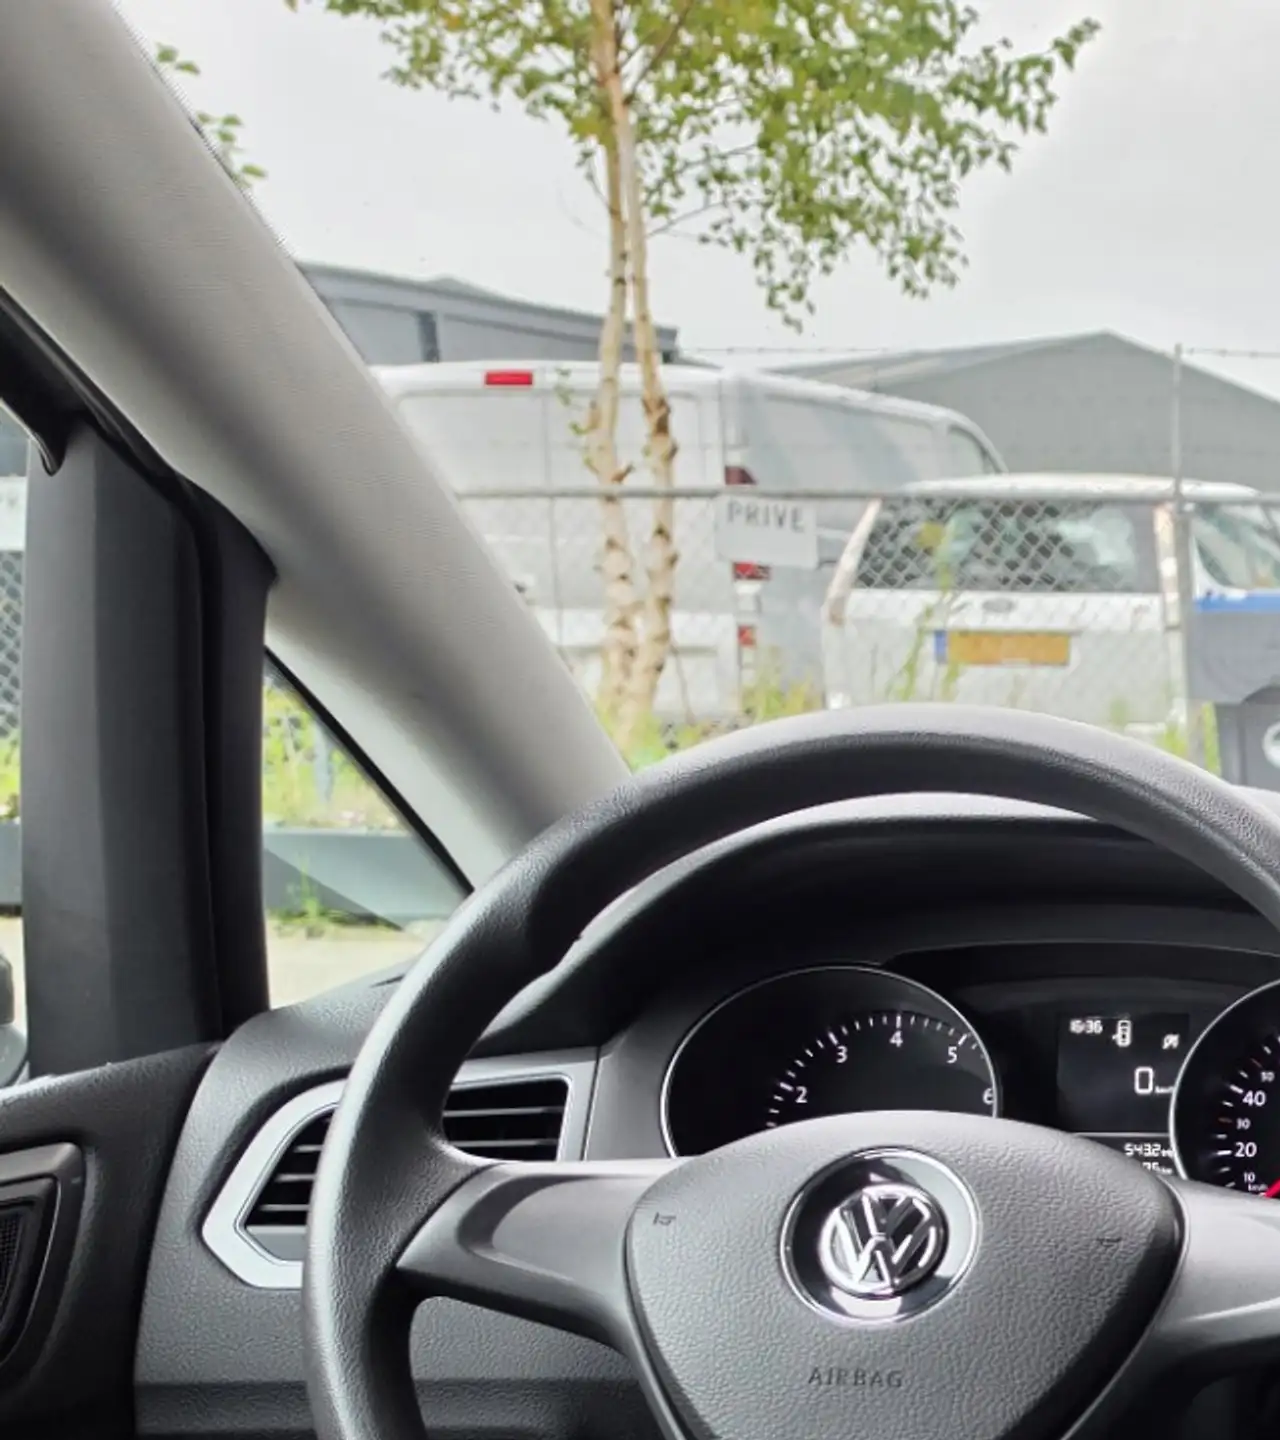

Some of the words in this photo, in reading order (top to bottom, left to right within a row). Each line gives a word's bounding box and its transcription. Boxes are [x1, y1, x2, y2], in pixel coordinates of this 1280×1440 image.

[726, 499, 805, 533] PRIVE
[890, 1031, 903, 1048] 4
[836, 1046, 848, 1063] 3
[947, 1046, 958, 1064] 5
[1134, 1067, 1153, 1095] 0
[795, 1086, 808, 1104] 2
[1242, 1090, 1266, 1106] 40
[1235, 1142, 1257, 1157] 20
[807, 1366, 904, 1388] AIRBAG
